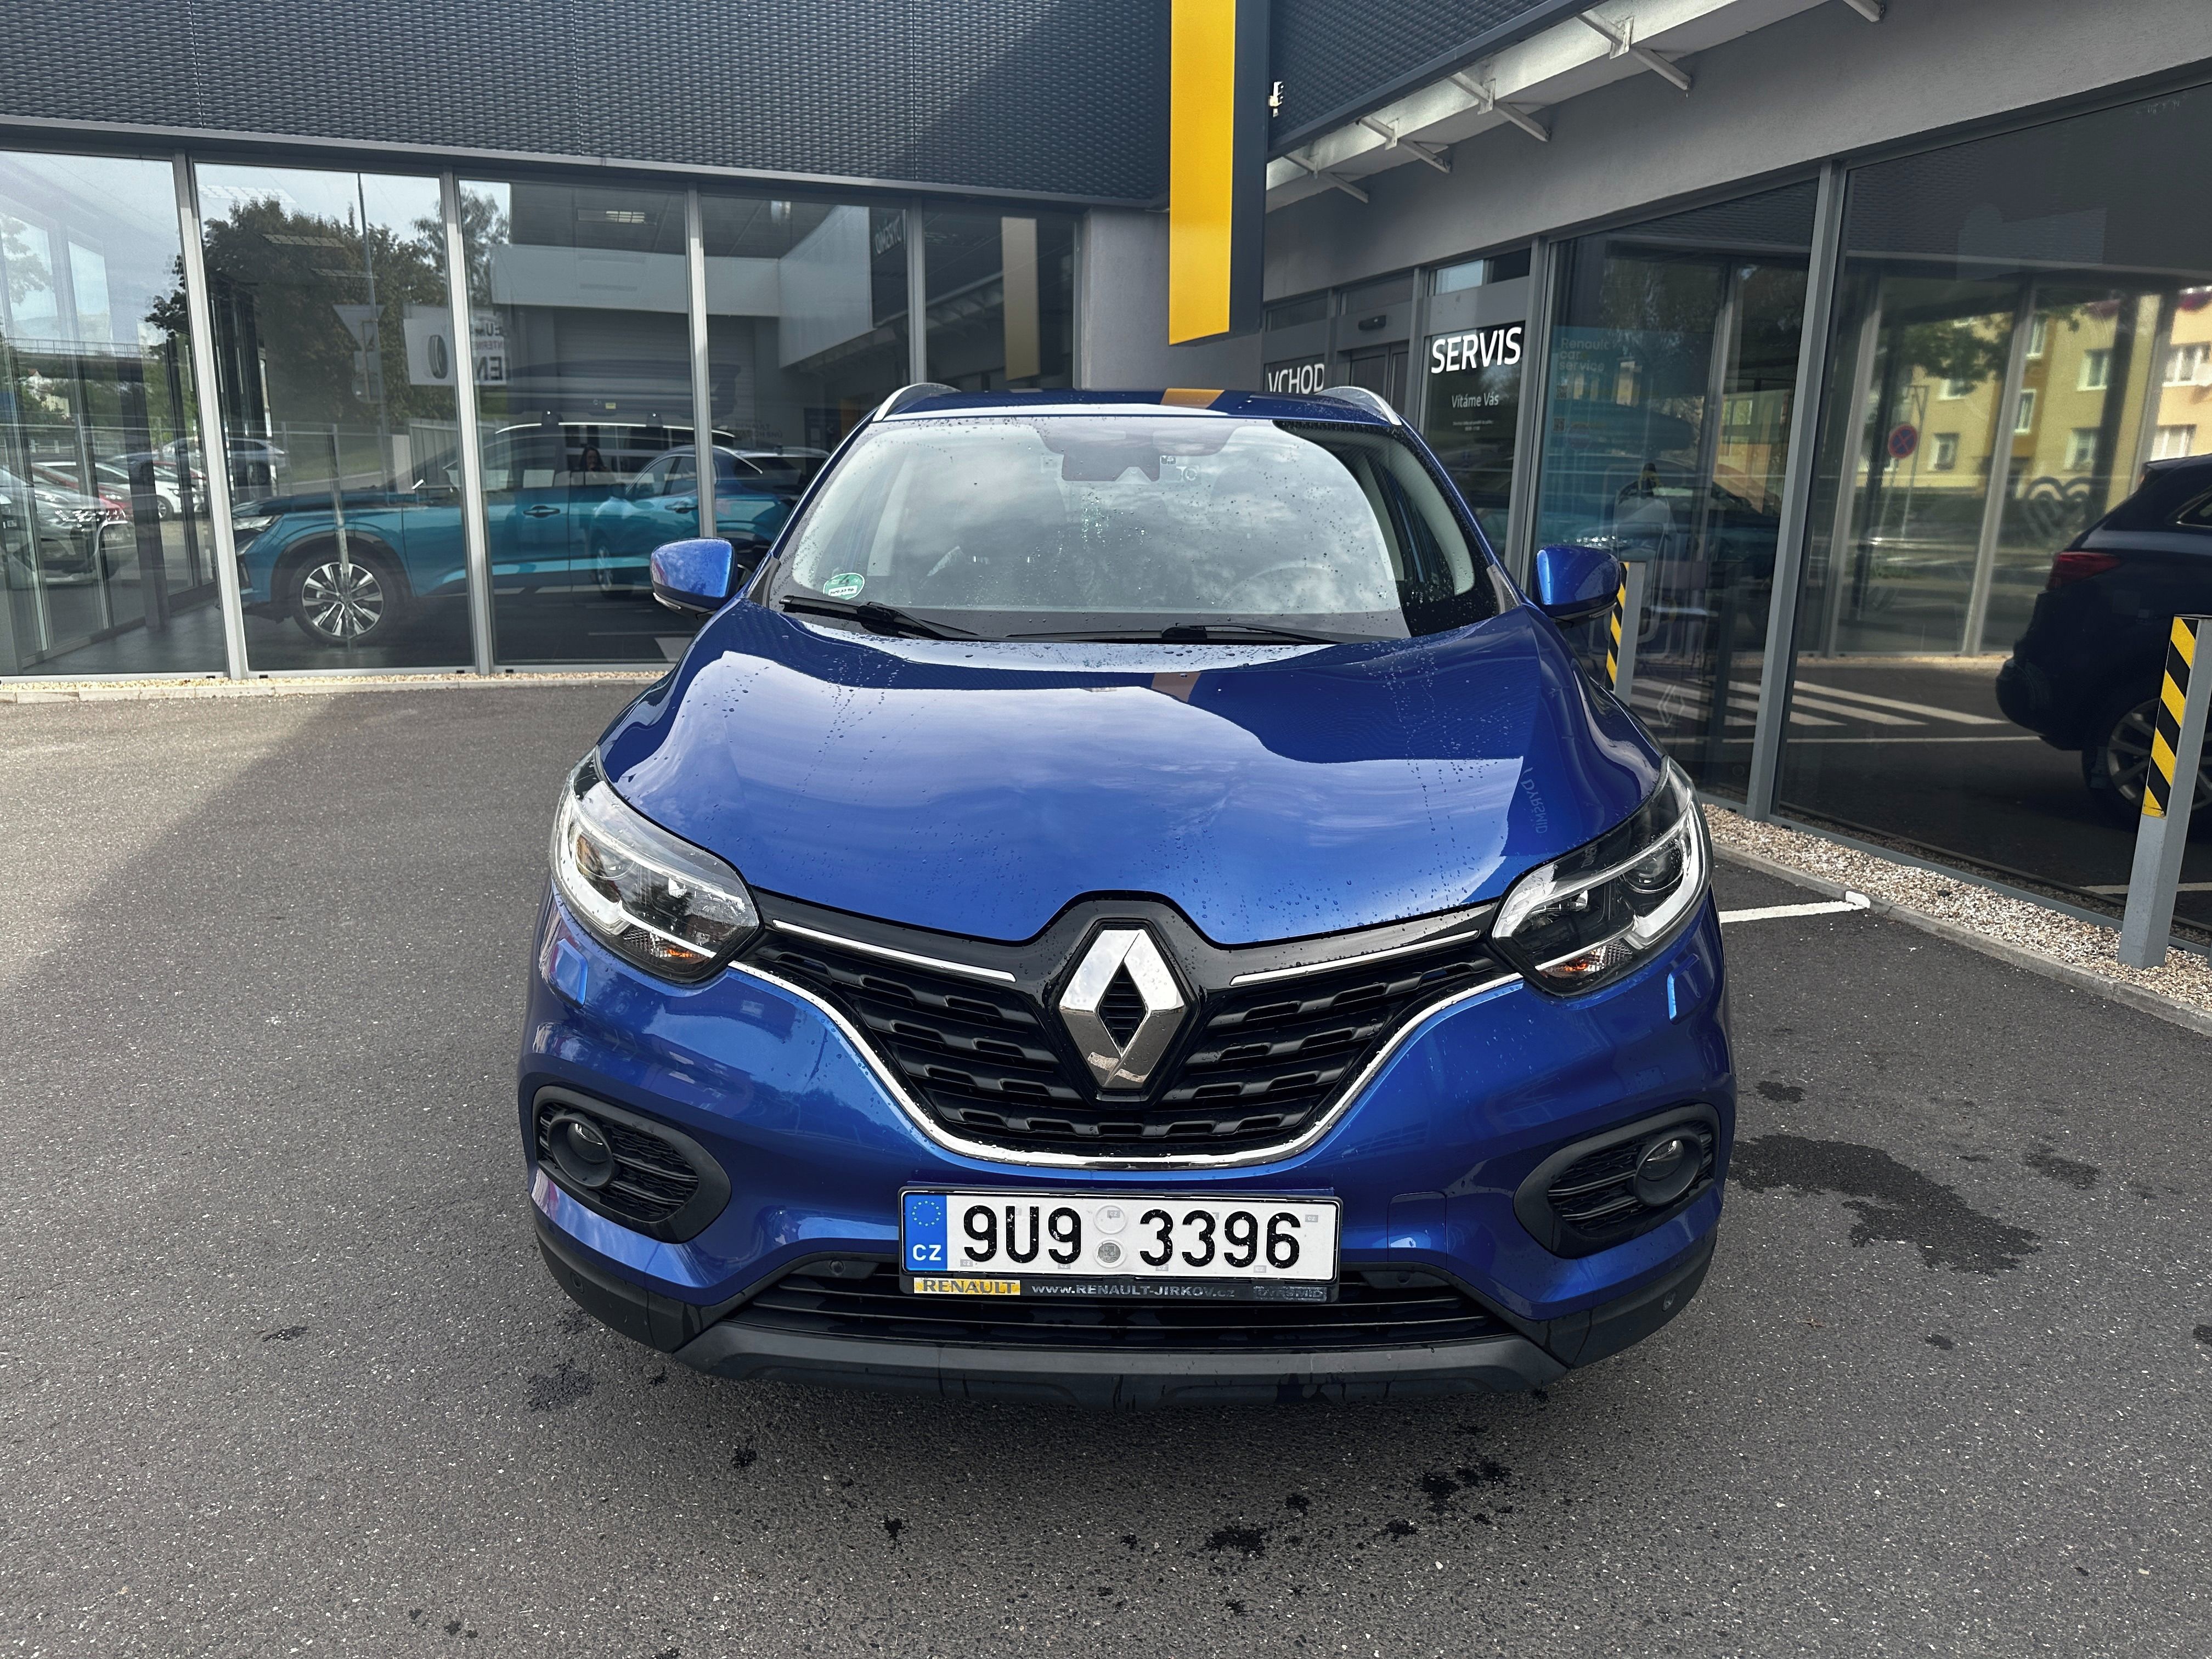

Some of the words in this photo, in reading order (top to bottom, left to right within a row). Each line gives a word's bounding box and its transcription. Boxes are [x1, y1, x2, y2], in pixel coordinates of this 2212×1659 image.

[1431, 327, 1522, 374] SERVIS
[1561, 337, 1609, 351] Renault
[1559, 360, 1605, 373] service
[1268, 363, 1325, 394] VCHOD
[1451, 393, 1482, 409] Vítáme
[1483, 391, 1500, 407] Vás
[964, 1205, 1081, 1265] 9U9
[1140, 1209, 1301, 1269] 3396
[912, 1244, 941, 1261] CZ
[923, 1279, 1015, 1294] RENAULT
